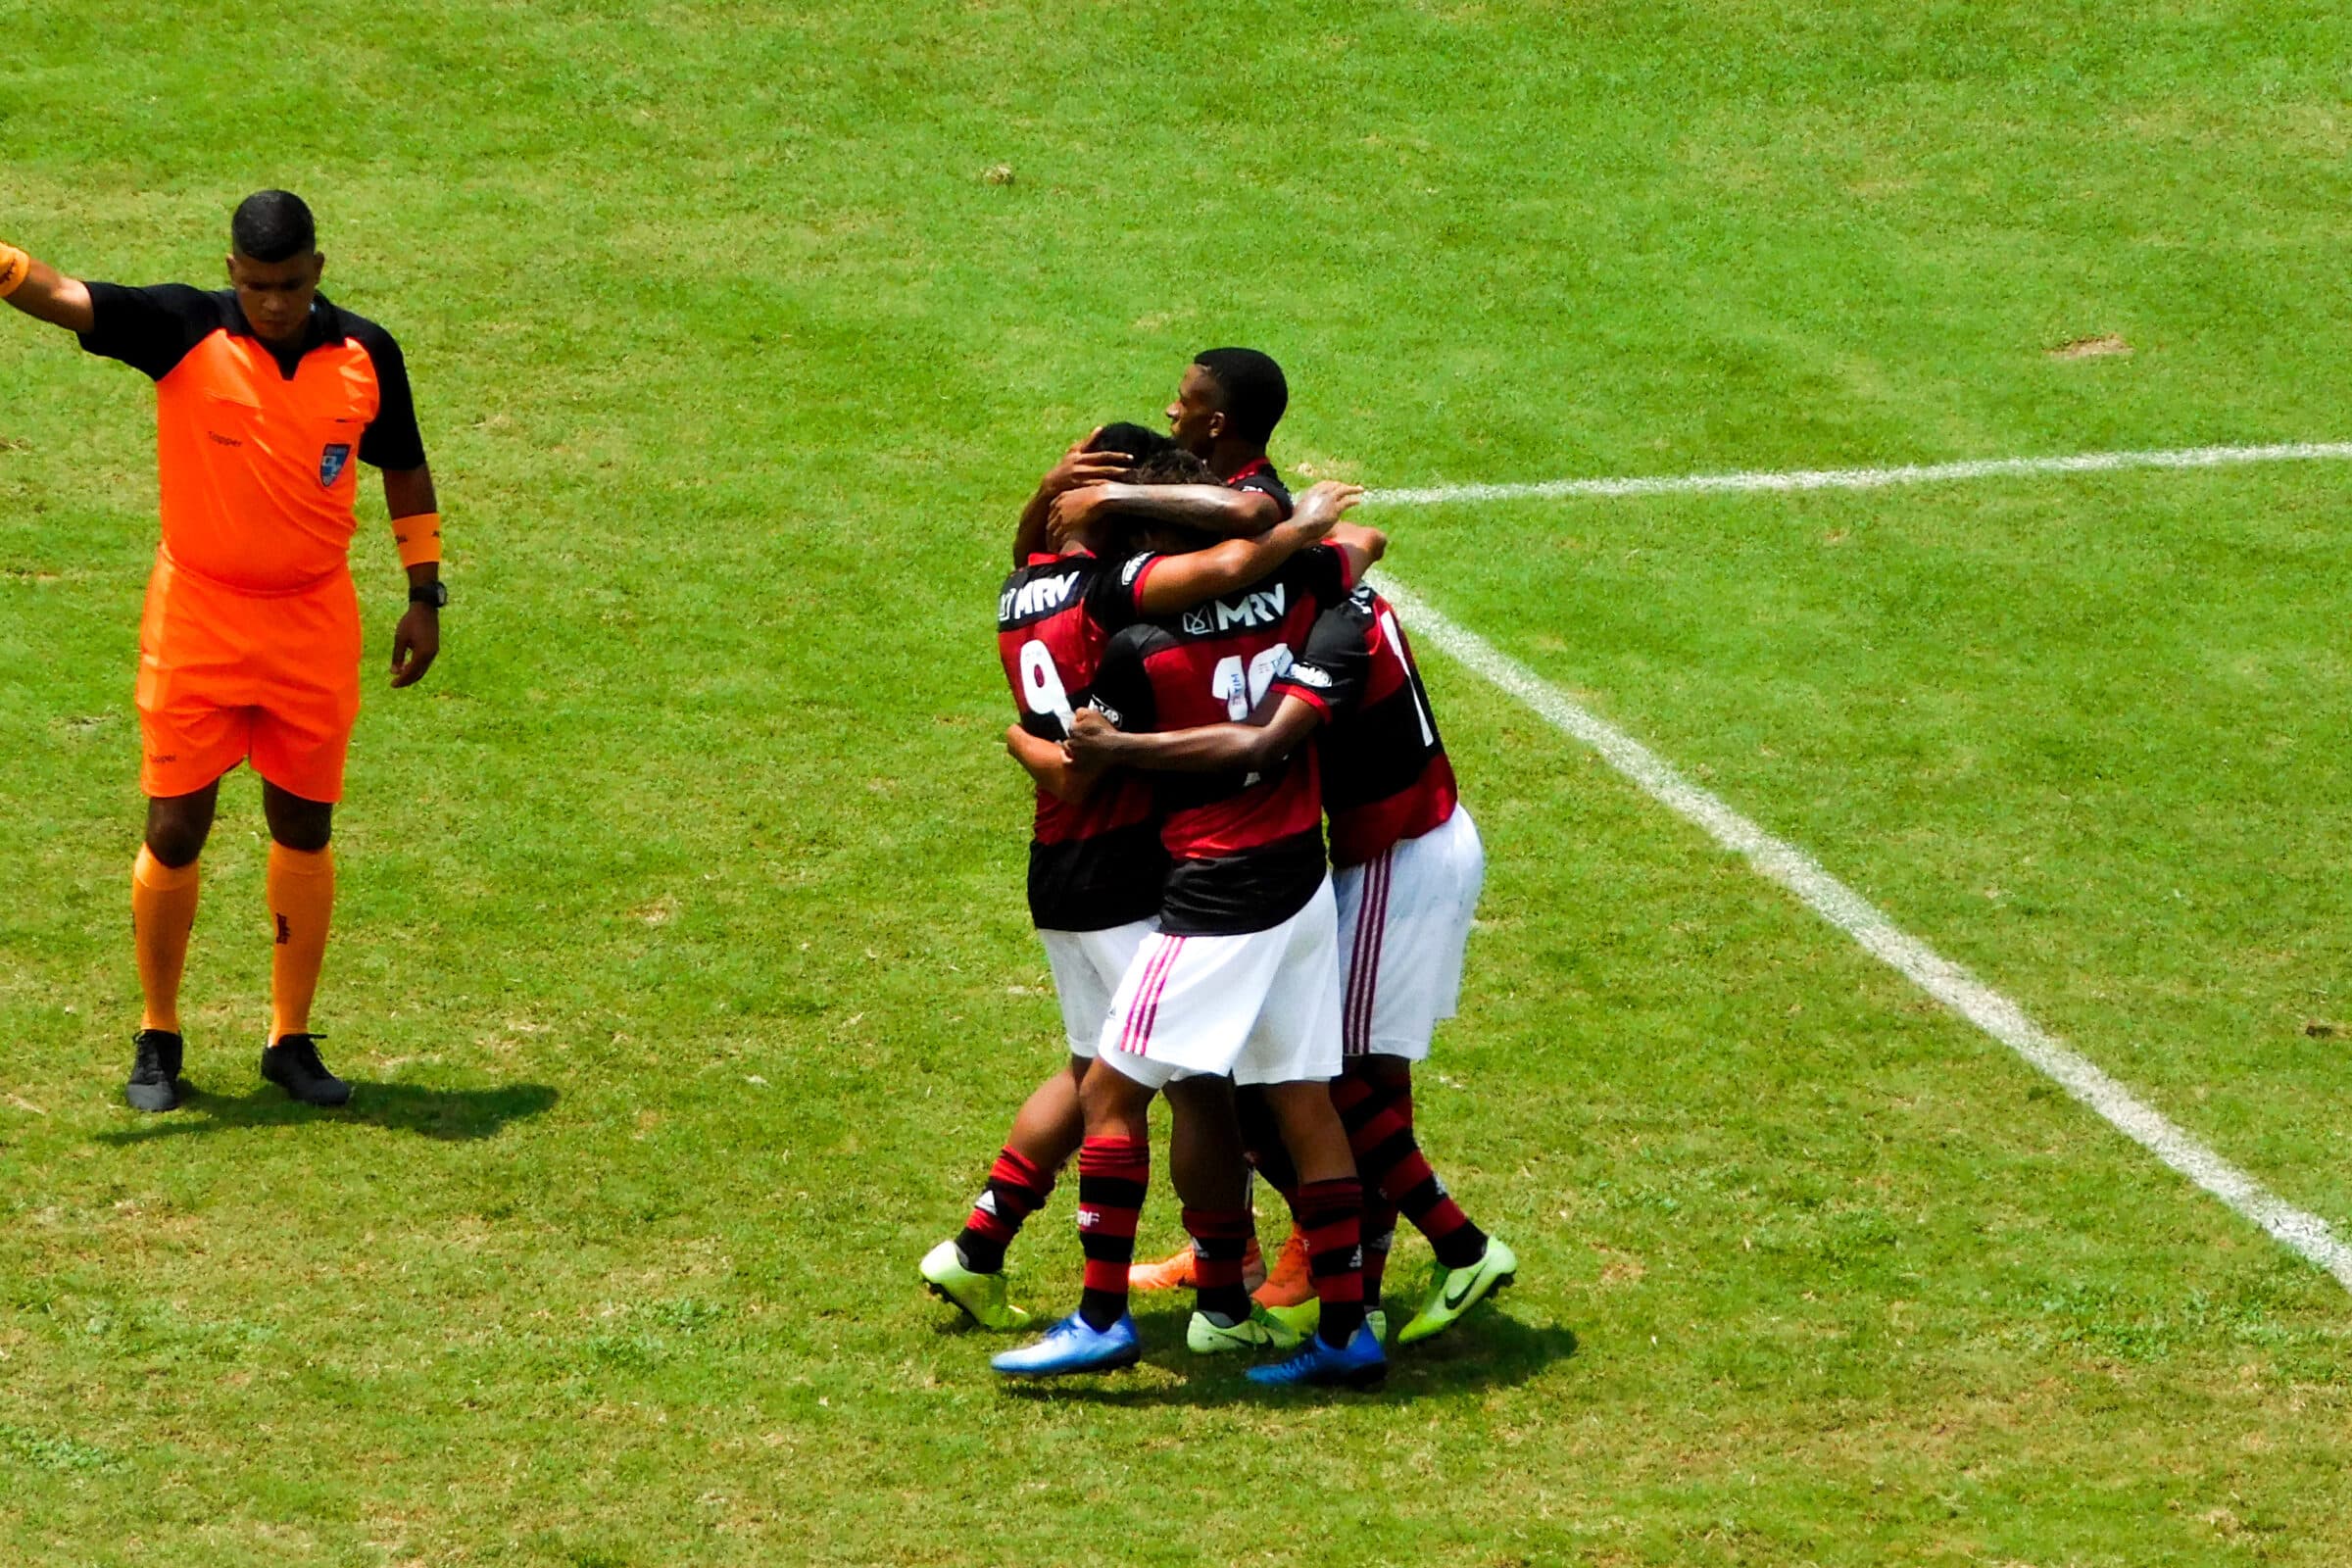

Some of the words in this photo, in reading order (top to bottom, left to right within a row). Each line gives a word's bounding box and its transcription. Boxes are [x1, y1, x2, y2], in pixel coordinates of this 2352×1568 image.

[207, 430, 242, 447] Topper
[1014, 571, 1081, 619] MRV
[1215, 583, 1286, 631] MRV
[1020, 639, 1076, 738] 9
